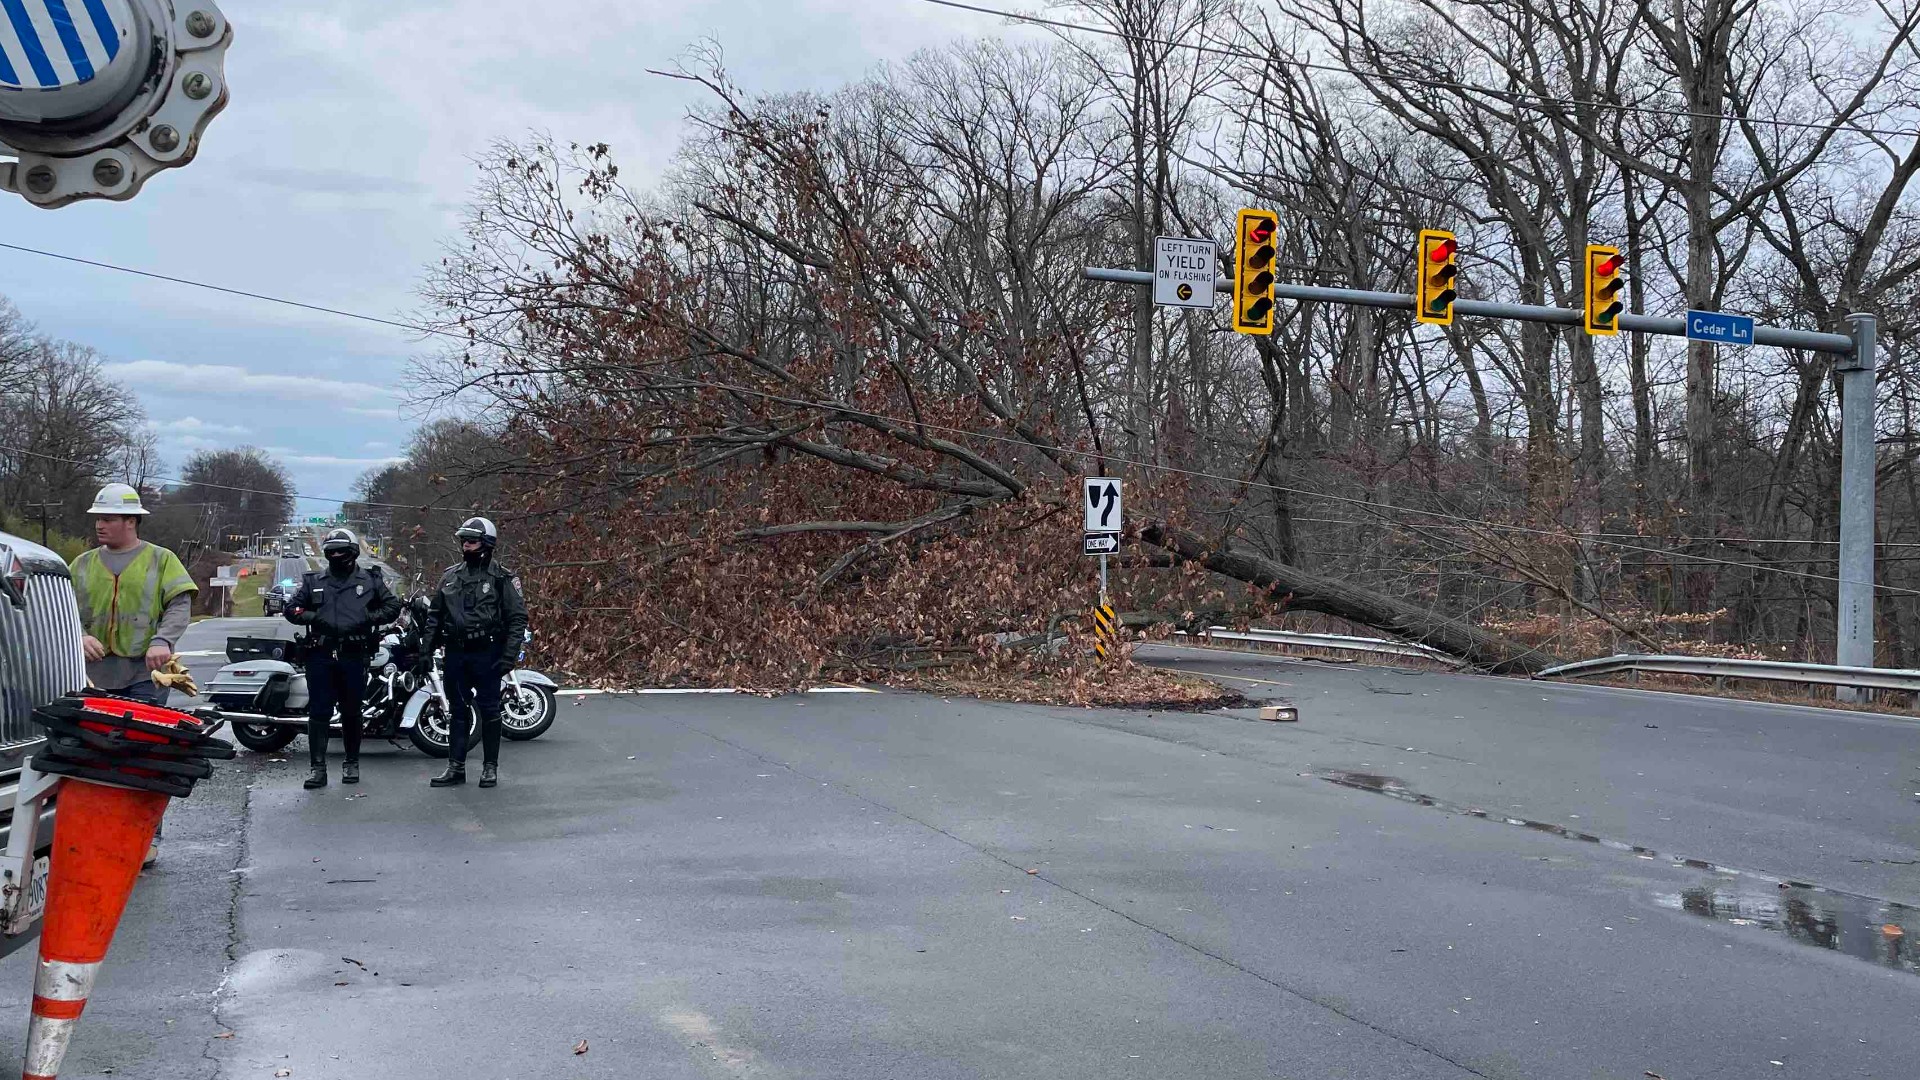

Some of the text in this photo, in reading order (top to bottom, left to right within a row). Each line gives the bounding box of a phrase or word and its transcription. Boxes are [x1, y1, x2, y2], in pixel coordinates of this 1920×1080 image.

[1162, 243, 1211, 255] LEFT TURN
[1167, 255, 1205, 270] YIELD
[1159, 270, 1212, 282] ON FLASHING
[1693, 318, 1747, 338] Cedar Ln
[1087, 539, 1109, 548] ONE WAY
